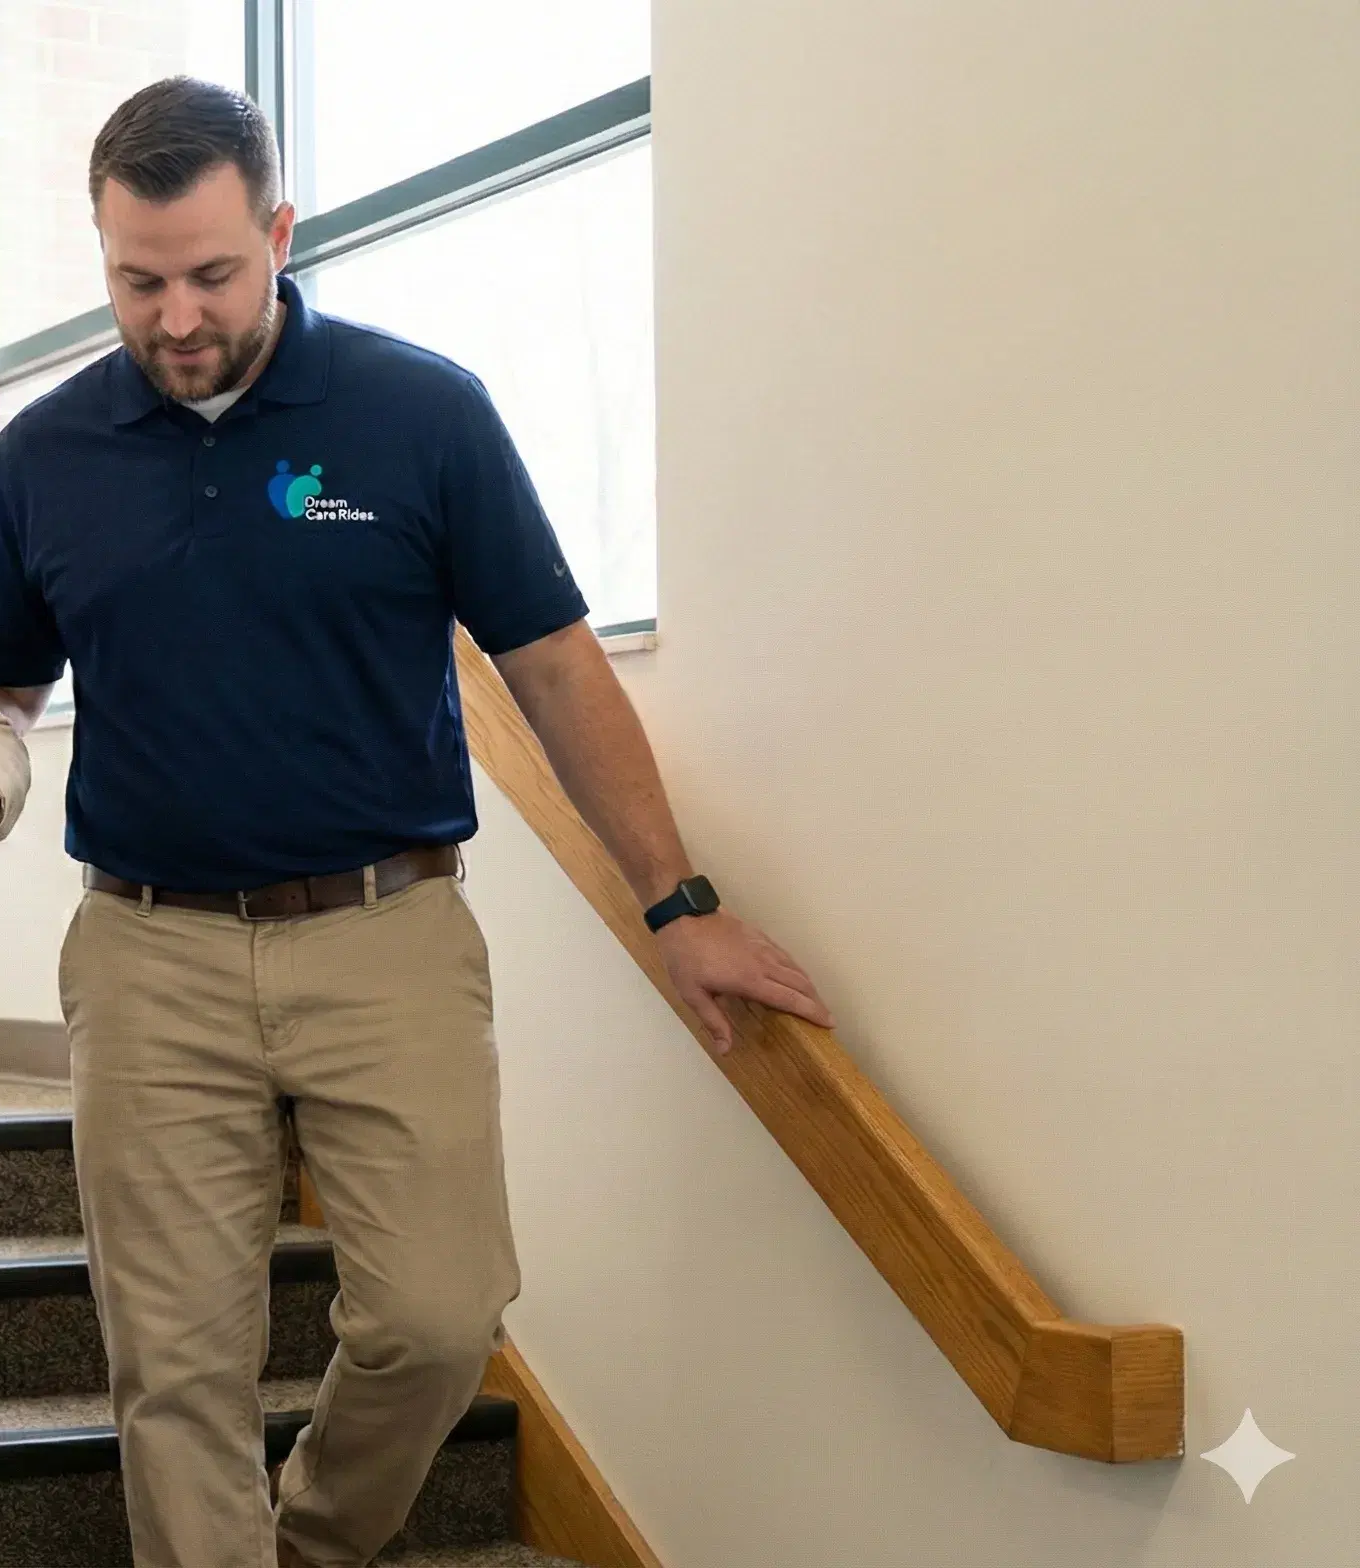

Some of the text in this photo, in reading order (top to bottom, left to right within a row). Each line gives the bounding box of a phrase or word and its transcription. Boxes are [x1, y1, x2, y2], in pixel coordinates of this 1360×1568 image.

[305, 496, 348, 508] Dream
[305, 508, 375, 521] Care Rides
